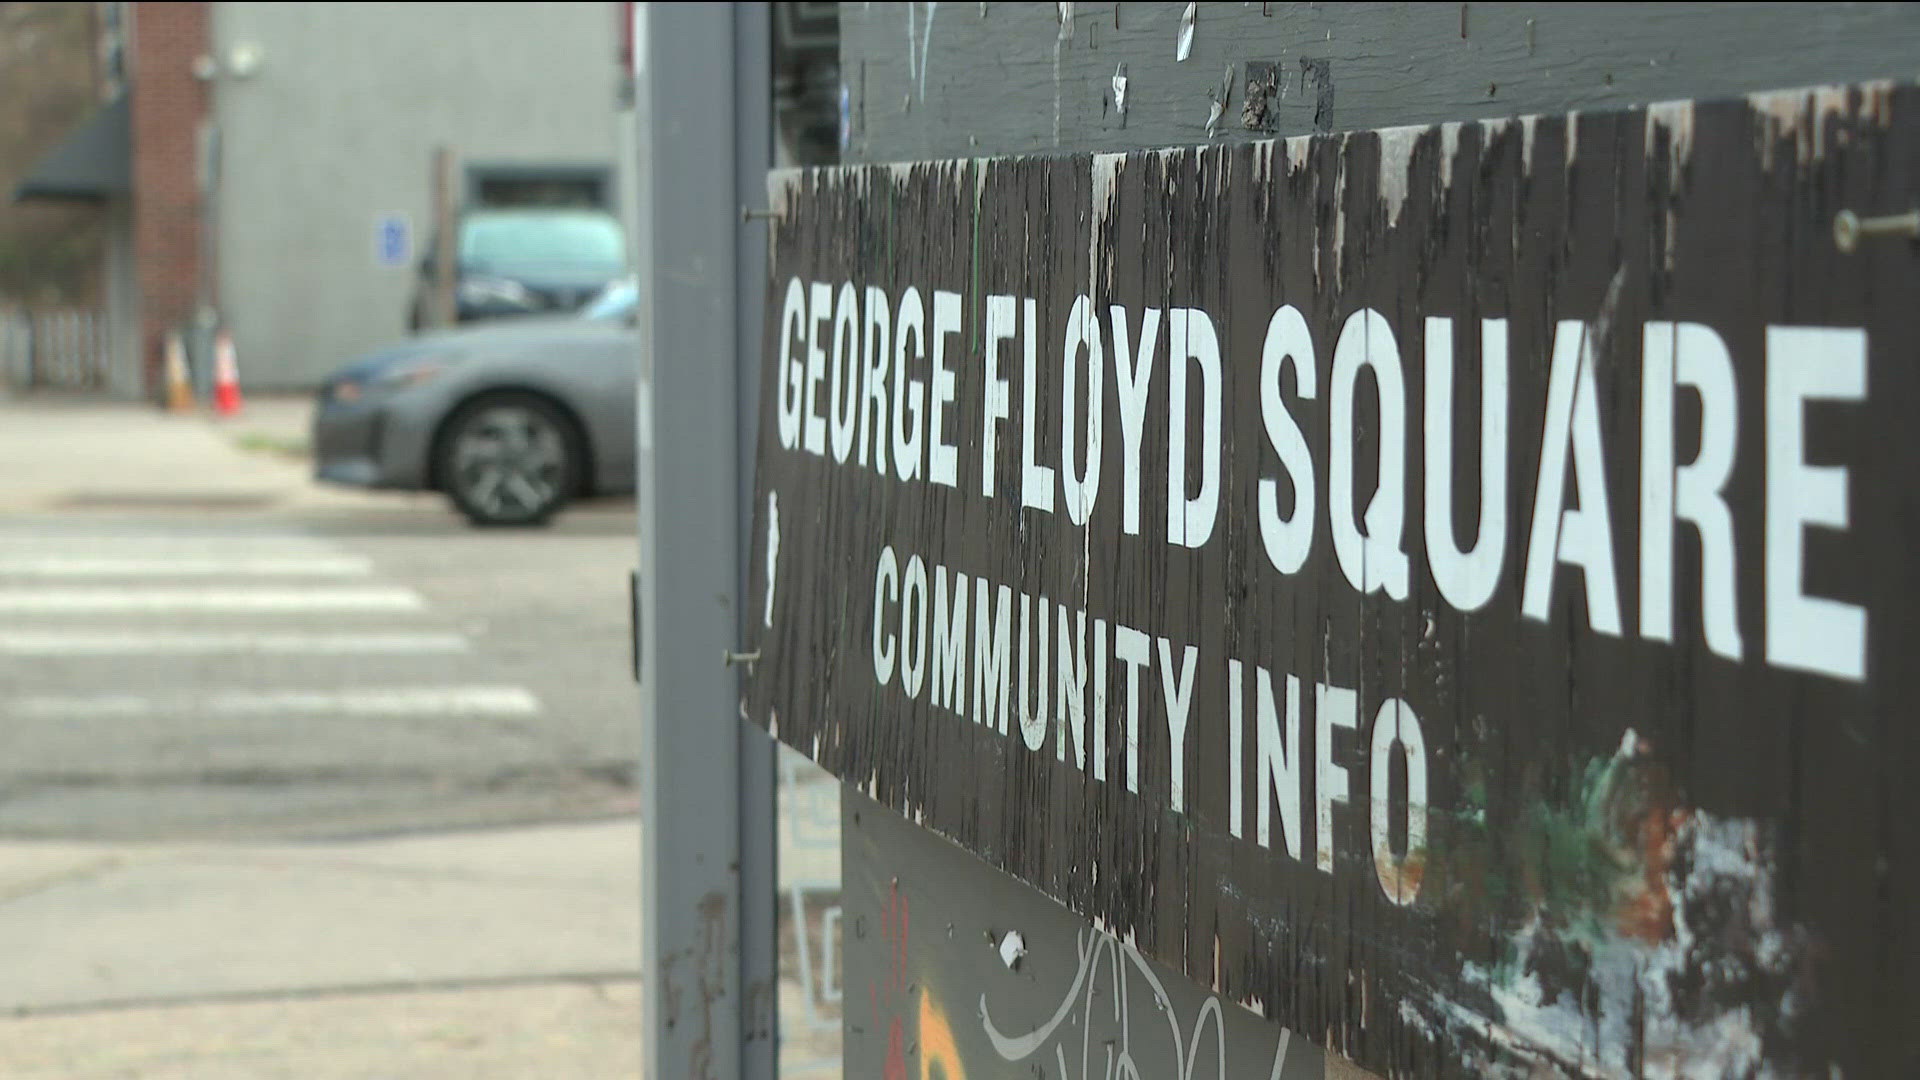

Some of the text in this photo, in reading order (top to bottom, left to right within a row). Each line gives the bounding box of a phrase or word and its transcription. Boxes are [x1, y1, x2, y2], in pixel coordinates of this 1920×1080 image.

[777, 276, 1868, 682] GEORGE FLOYD SQUARE
[873, 545, 1429, 906] COMMUNITY INFO
